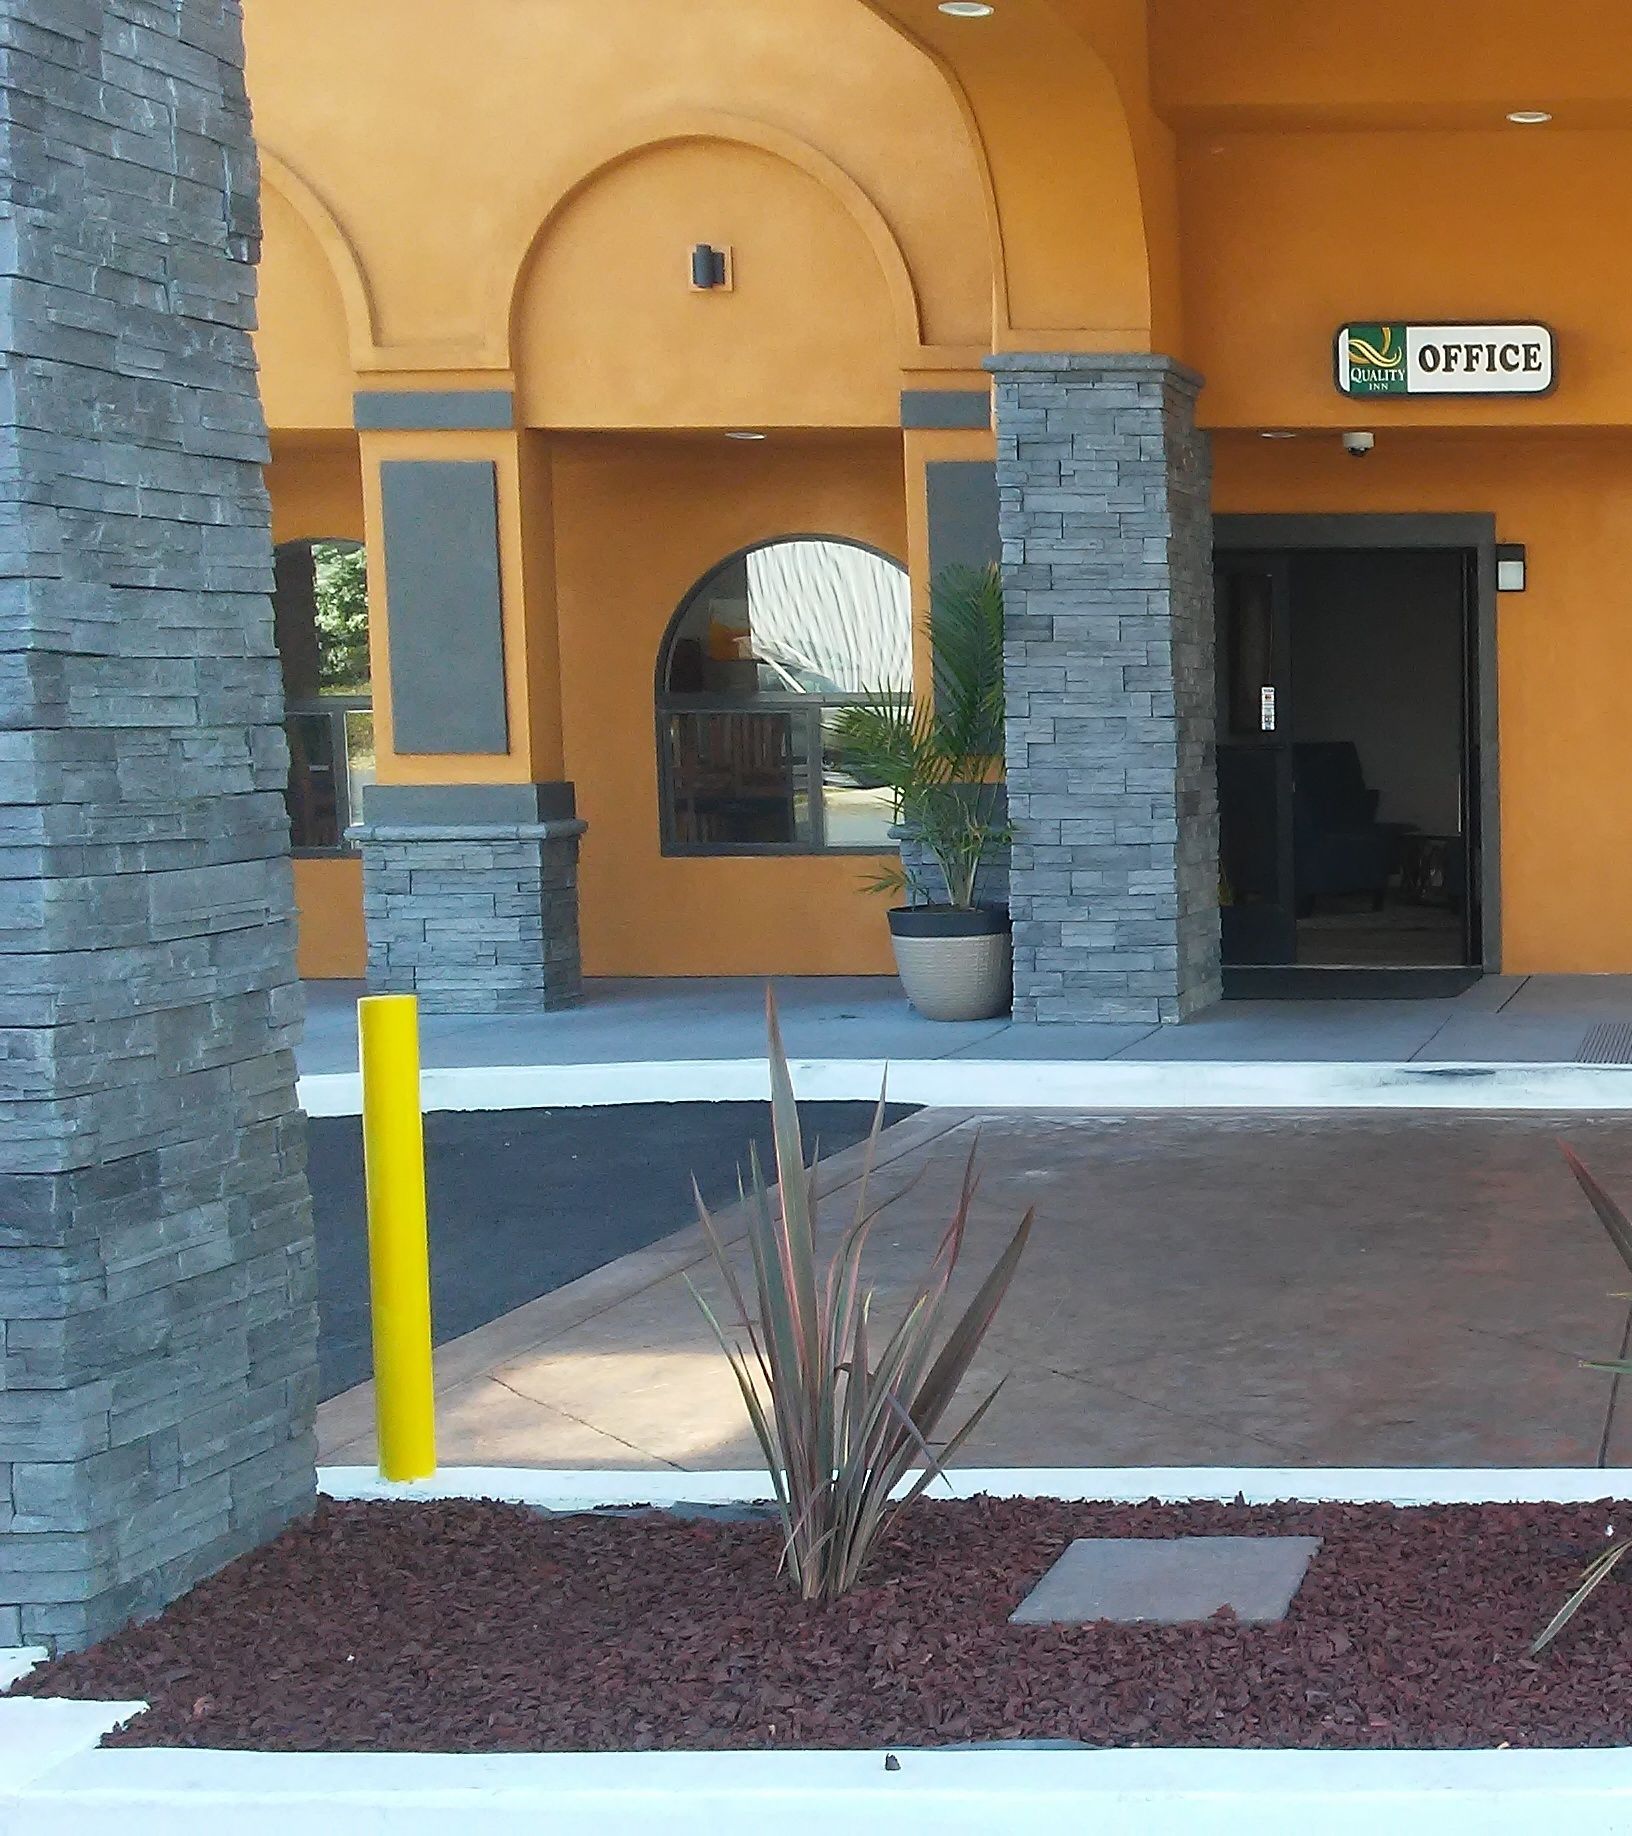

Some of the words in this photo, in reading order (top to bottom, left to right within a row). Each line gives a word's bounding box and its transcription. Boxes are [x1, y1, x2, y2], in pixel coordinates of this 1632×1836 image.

[1418, 343, 1543, 373] OFFICE
[1351, 368, 1405, 383] QUALITY
[1369, 383, 1389, 391] INN
